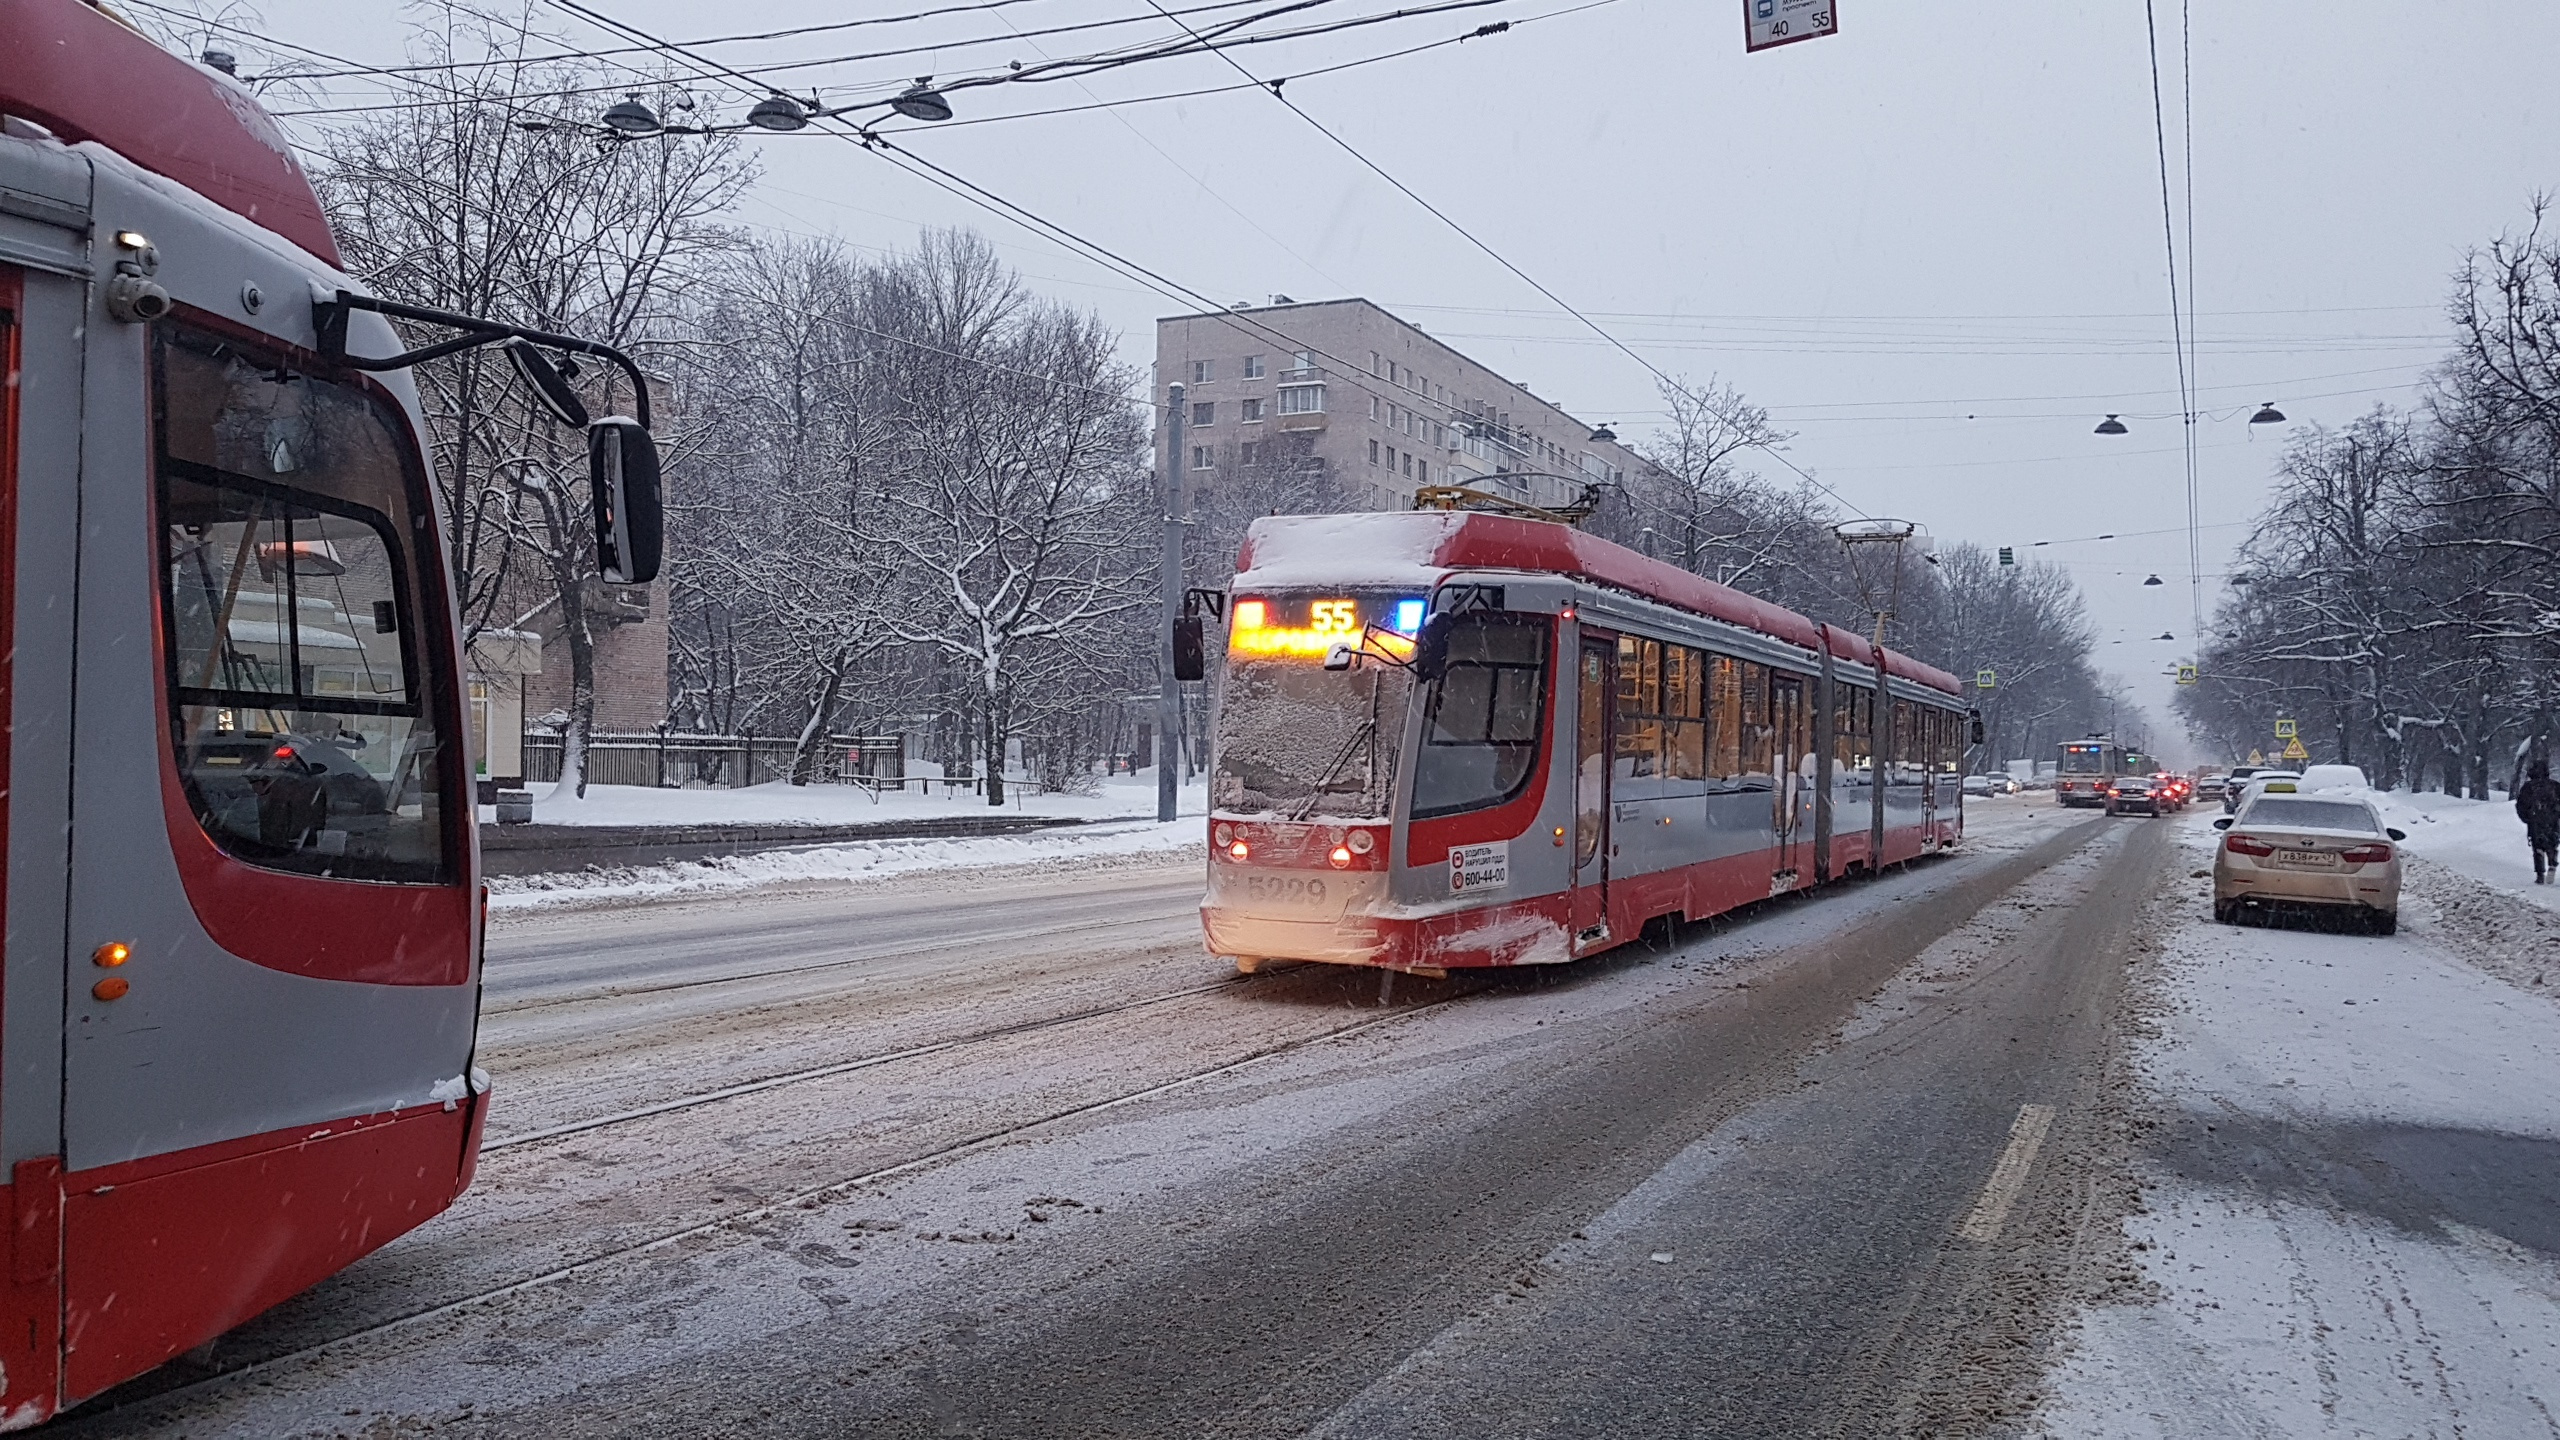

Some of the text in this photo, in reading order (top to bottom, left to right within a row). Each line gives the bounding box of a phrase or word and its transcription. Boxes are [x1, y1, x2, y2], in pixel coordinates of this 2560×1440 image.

[1771, 11, 1830, 37] 40 55
[1312, 601, 1355, 631] 55
[1465, 847, 1492, 858] ВОДИТЕЛЬ
[1465, 856, 1491, 867] НАРУШИЛ
[1465, 867, 1505, 886] 600-44-00
[1248, 876, 1326, 905] 5229
